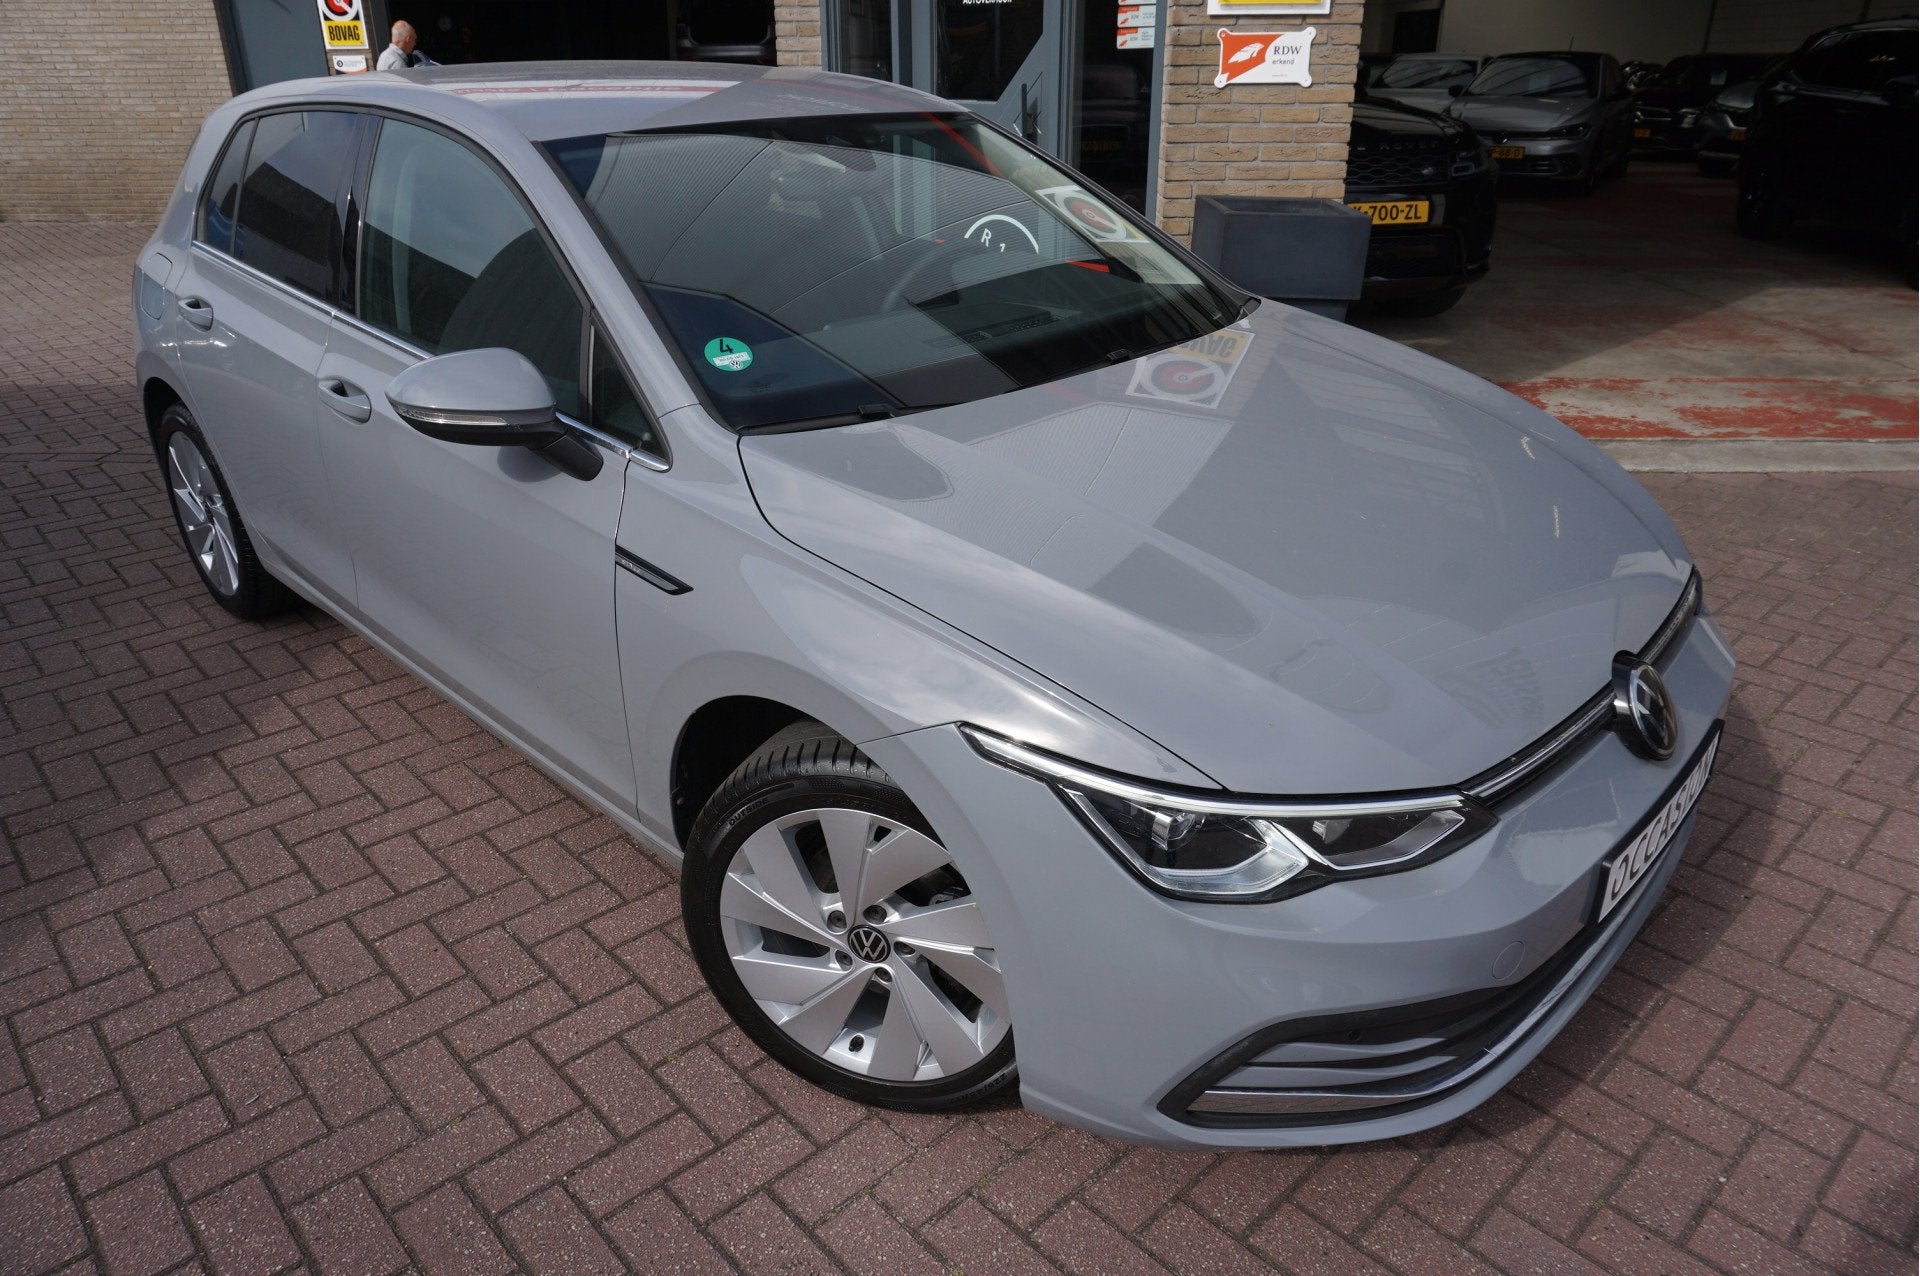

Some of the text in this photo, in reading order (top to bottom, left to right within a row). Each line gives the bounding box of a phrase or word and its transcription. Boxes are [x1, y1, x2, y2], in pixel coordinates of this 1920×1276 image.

[328, 25, 360, 41] BOVAG
[1273, 45, 1302, 55] RDW
[719, 338, 734, 353] 4
[728, 798, 770, 826] OUTSIDE
